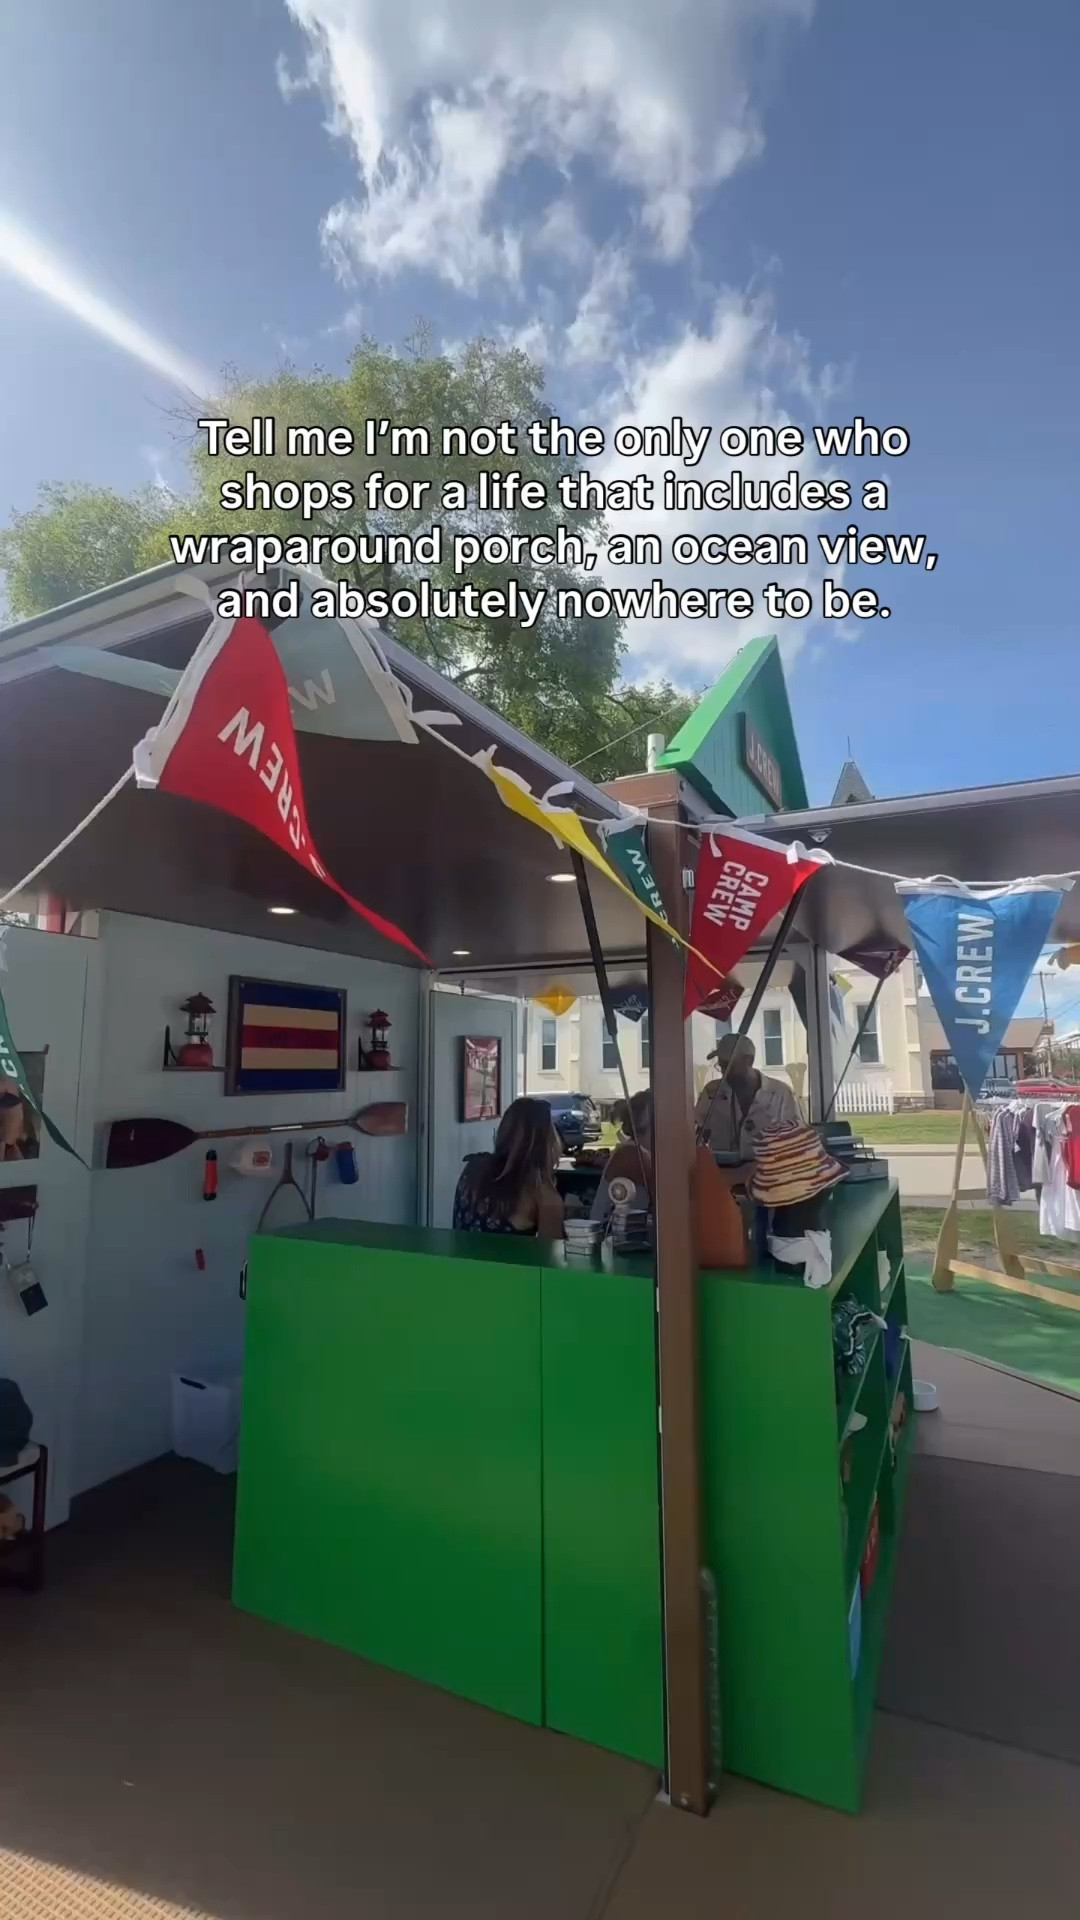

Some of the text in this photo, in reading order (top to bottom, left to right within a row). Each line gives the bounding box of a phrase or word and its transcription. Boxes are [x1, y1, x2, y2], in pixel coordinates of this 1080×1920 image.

[702, 860, 747, 928] CREW
[726, 870, 770, 932] CAMP
[955, 912, 995, 1036] J.CREW
